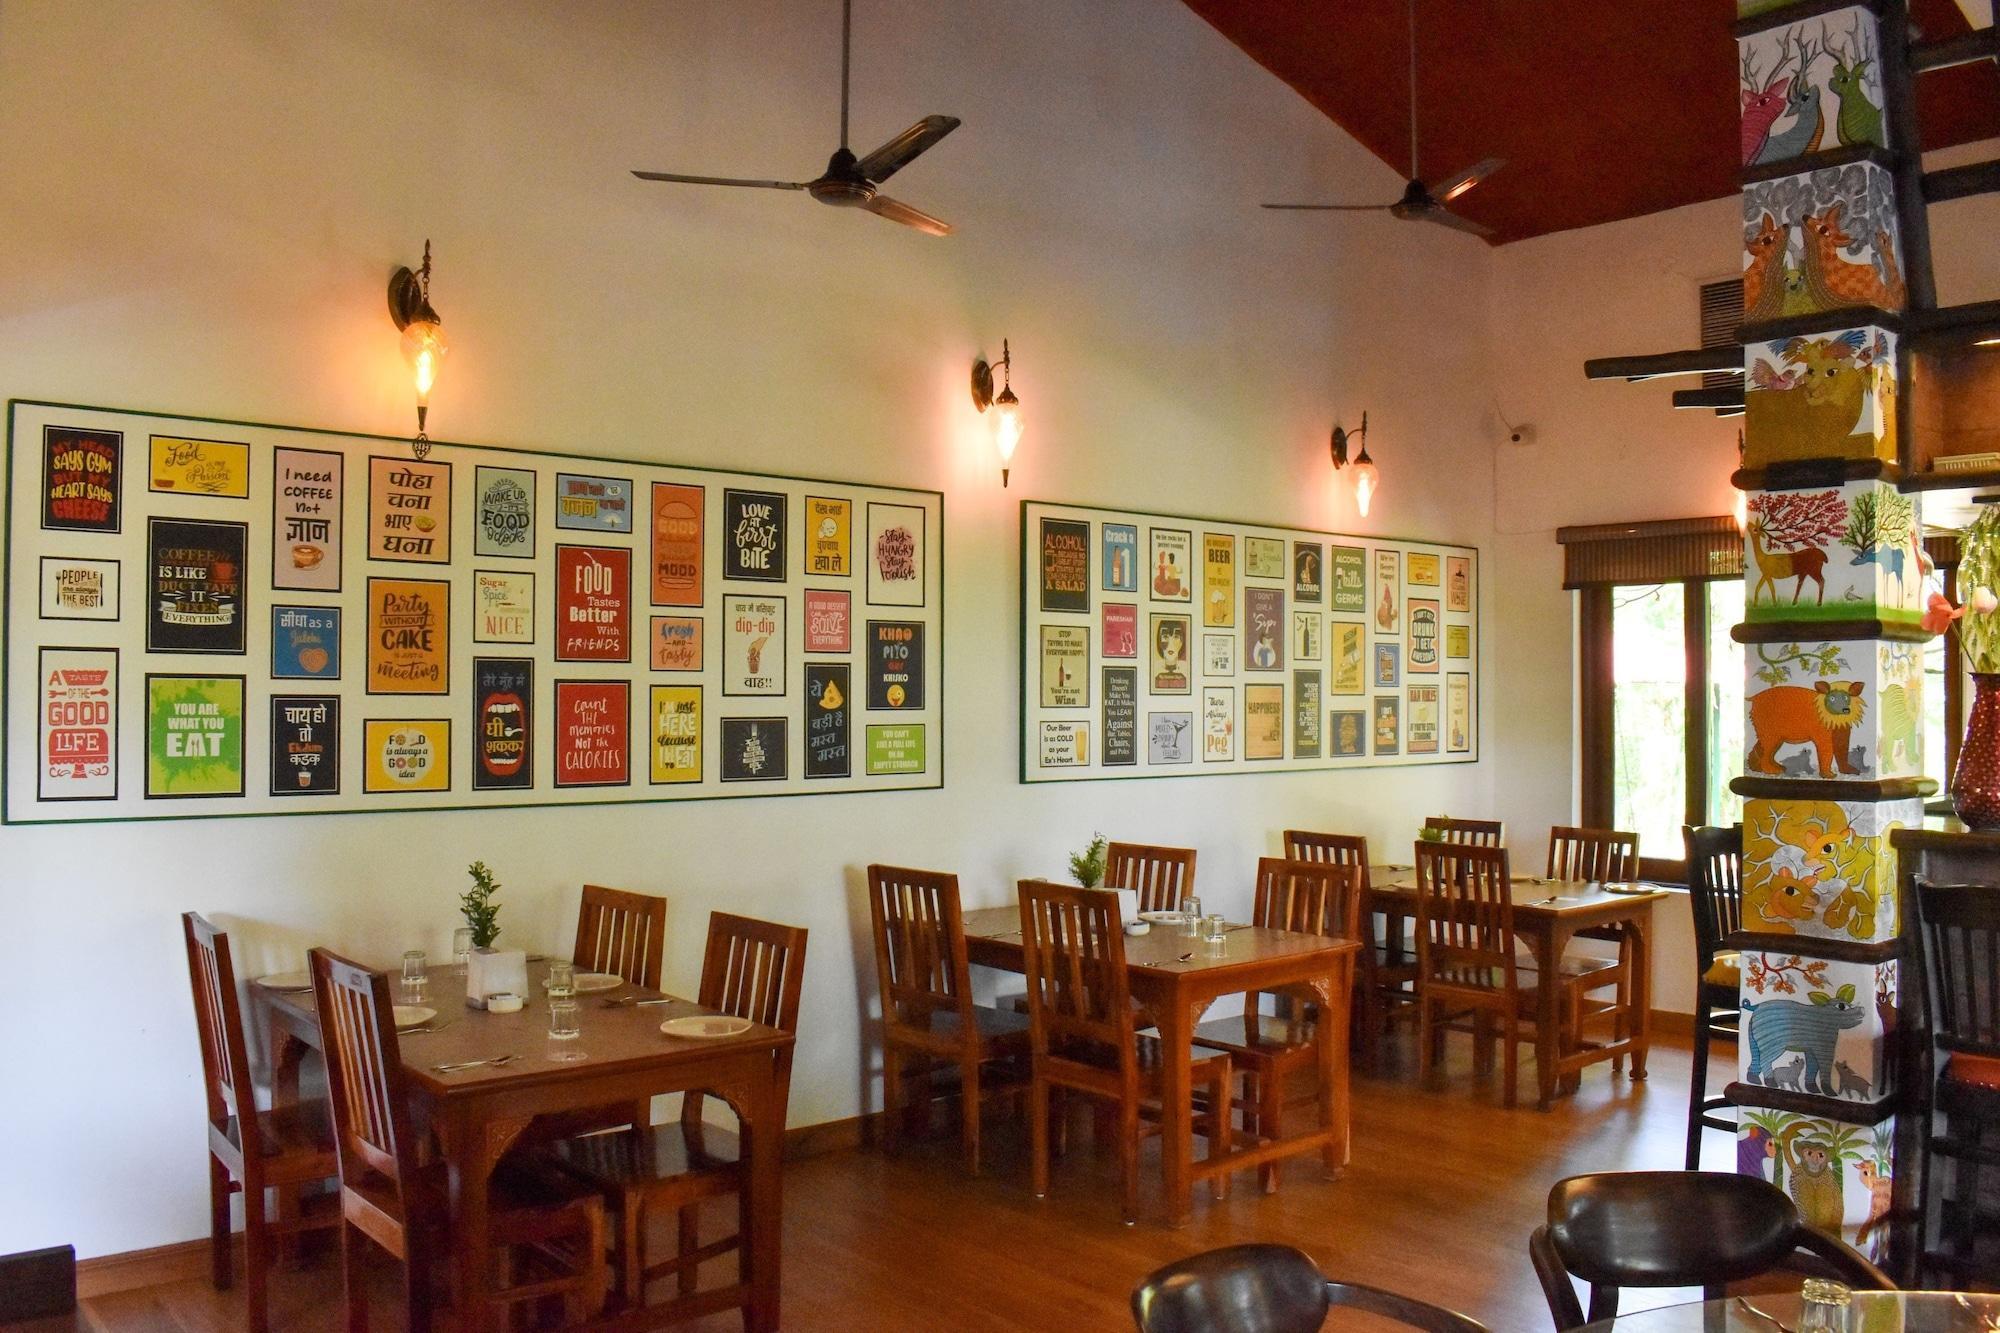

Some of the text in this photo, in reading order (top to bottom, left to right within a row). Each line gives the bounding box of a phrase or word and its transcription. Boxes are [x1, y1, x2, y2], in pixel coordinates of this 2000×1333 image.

[53, 450, 112, 474] SAYS GYM
[285, 468, 332, 483] I need
[390, 468, 434, 489] पोहा
[51, 482, 113, 504] HEART SAYS
[284, 486, 333, 499] COFFEE
[484, 490, 512, 504] WAKE
[387, 492, 432, 510] चना
[51, 500, 110, 522] CHEESE
[741, 503, 772, 520] LOVE
[384, 514, 413, 531] भाए
[481, 509, 529, 530] FOOD
[750, 518, 761, 527] AT
[734, 519, 778, 550] first
[1106, 530, 1128, 543] Crack
[383, 535, 435, 555] घना
[878, 543, 914, 557] HUNGRY
[159, 548, 217, 561] COFFEE
[814, 554, 842, 571] खा ले
[1208, 548, 1230, 564] BEER
[1336, 555, 1362, 564] ALCOHOL
[159, 566, 207, 580] IS LIKE
[658, 563, 697, 577] MOOD
[1121, 548, 1130, 587] 1
[61, 569, 99, 586] PEOPLE
[480, 577, 507, 588] Sugar
[575, 562, 612, 595] FOOD
[1046, 581, 1086, 592] A SALAD
[1296, 583, 1319, 593] ALCOHOL
[62, 594, 99, 608] THE BEST
[190, 591, 206, 602] IT
[482, 587, 508, 603] Spice
[587, 596, 620, 607] Tastes
[1335, 593, 1363, 604] GERMS
[383, 593, 430, 625] Party
[569, 606, 617, 623] Better
[165, 612, 229, 623] EVERYTHING
[280, 610, 333, 628] सीधा as a
[384, 617, 423, 626] WITHOUT
[486, 616, 524, 635] NICE
[736, 617, 775, 634] dip-dip
[596, 626, 620, 635] With
[879, 627, 912, 641] KHAO
[381, 629, 433, 651] CAKE
[883, 643, 908, 659] PIYO
[49, 670, 62, 686] A
[883, 673, 909, 682] KHISKO
[1055, 696, 1076, 705] Wine
[1248, 702, 1281, 714] HAPPINESS
[48, 701, 109, 725] GOOD
[174, 703, 219, 716] YOU ARE
[285, 703, 327, 724] चाय हो
[168, 717, 225, 730] WHAT YOU
[486, 716, 504, 737] घी
[660, 713, 696, 735] HERE
[1107, 719, 1133, 729] Against
[298, 725, 313, 742] तो
[811, 732, 835, 748] मस्त
[55, 733, 99, 752] LIFE
[166, 733, 225, 757] EAT
[1207, 734, 1228, 753] Peg
[386, 747, 393, 755] is
[393, 746, 422, 758] always
[566, 750, 621, 770] CALORIES
[399, 769, 416, 778] idea
